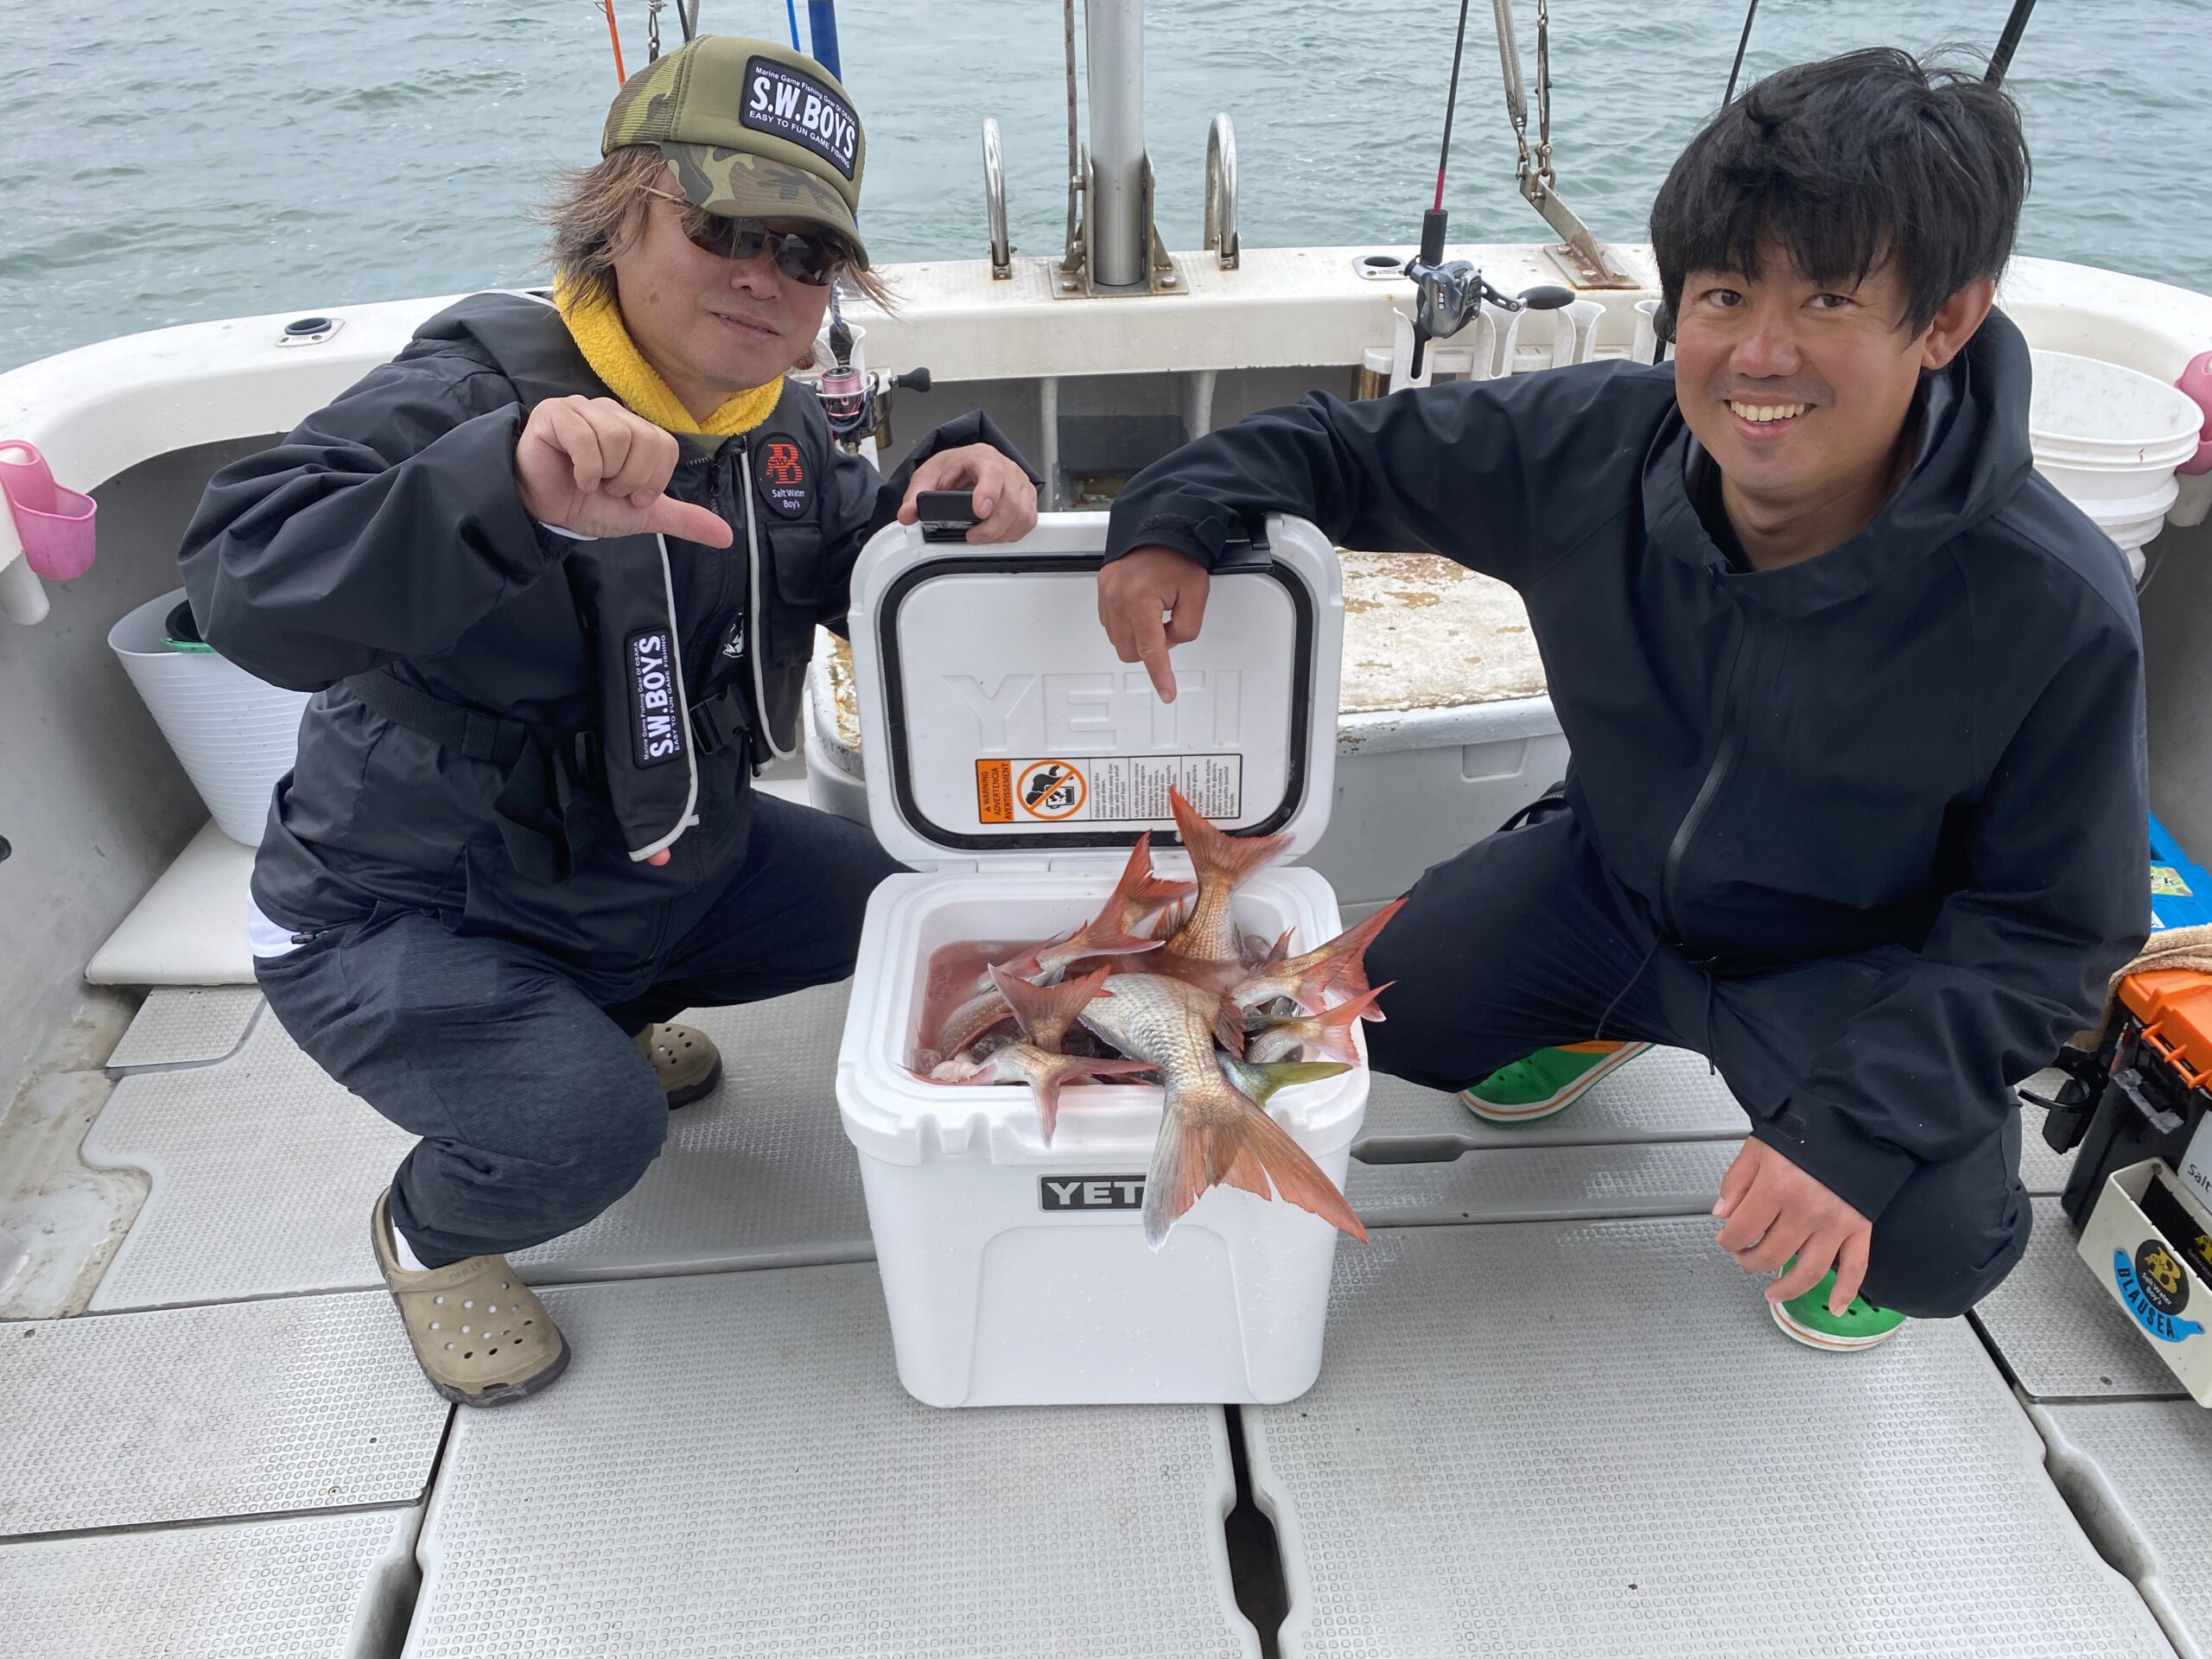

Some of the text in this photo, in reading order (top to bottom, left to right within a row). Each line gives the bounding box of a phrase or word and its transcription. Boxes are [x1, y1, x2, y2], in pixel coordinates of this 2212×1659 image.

[755, 66, 779, 79] Marine
[781, 75, 800, 87] Game
[801, 83, 823, 99] Fishing
[824, 95, 835, 108] Gear
[750, 76, 855, 159] S.W.BOYS
[749, 110, 850, 168] EASY TO FUN GAME FISHING
[772, 489, 805, 497] Salt Water
[783, 500, 800, 509] Boy's
[661, 635, 669, 667] FISHING
[639, 635, 674, 757] S.W.BOYS
[672, 715, 676, 727] TO
[981, 771, 990, 805] WARNING
[992, 767, 1001, 816] ADVERTENCIA
[1002, 763, 1012, 820] AVERTISSEMENT
[1047, 1181, 1145, 1205] YET
[2187, 1164, 2212, 1193] Salt
[2117, 1268, 2174, 1339] BLAUSEA
[2152, 1285, 2172, 1306] Water
